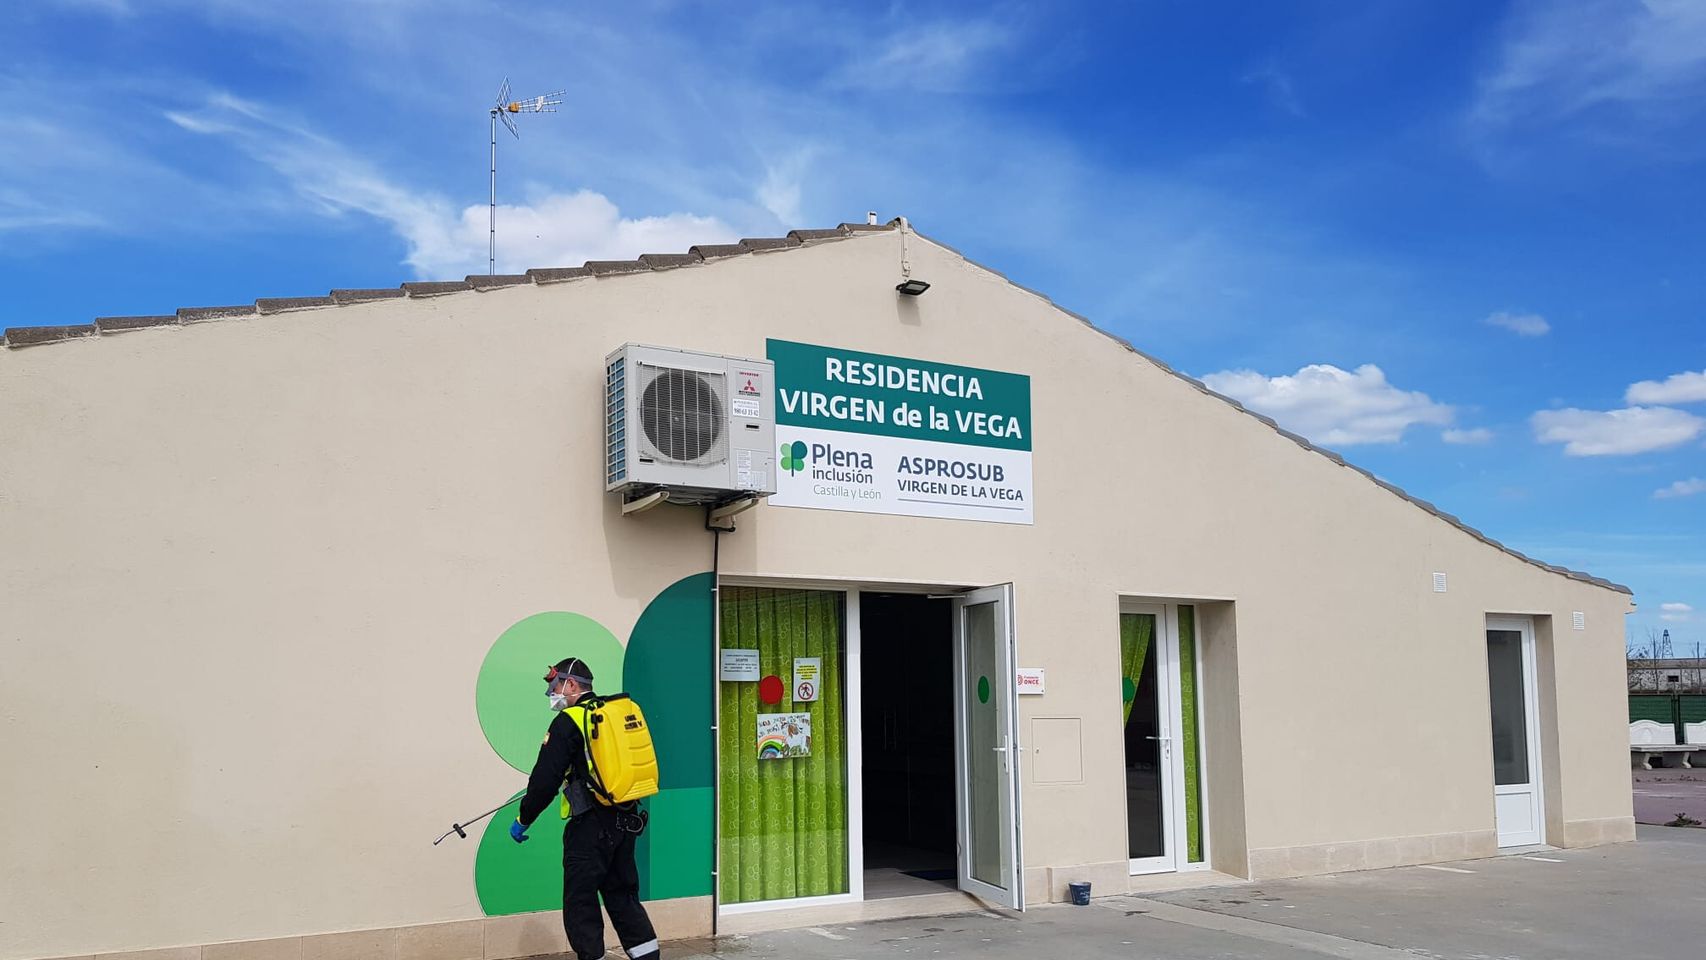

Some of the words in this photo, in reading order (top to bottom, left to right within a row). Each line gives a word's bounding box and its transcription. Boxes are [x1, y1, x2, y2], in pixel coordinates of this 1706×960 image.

[826, 357, 983, 400] RESIDENCIA
[779, 388, 885, 423] VIRGEN
[892, 402, 922, 428] de
[929, 405, 949, 431] la
[954, 410, 1022, 439] VEGA
[812, 443, 873, 469] Plena
[897, 456, 1004, 482] ASPROSUB
[812, 465, 873, 484] inclusión
[813, 484, 849, 498] Castilla
[850, 488, 857, 500] y
[859, 487, 881, 500] León
[897, 479, 948, 495] VIRGEN
[951, 484, 967, 497] DE
[971, 486, 987, 498] LA
[990, 487, 1023, 501] VEGA
